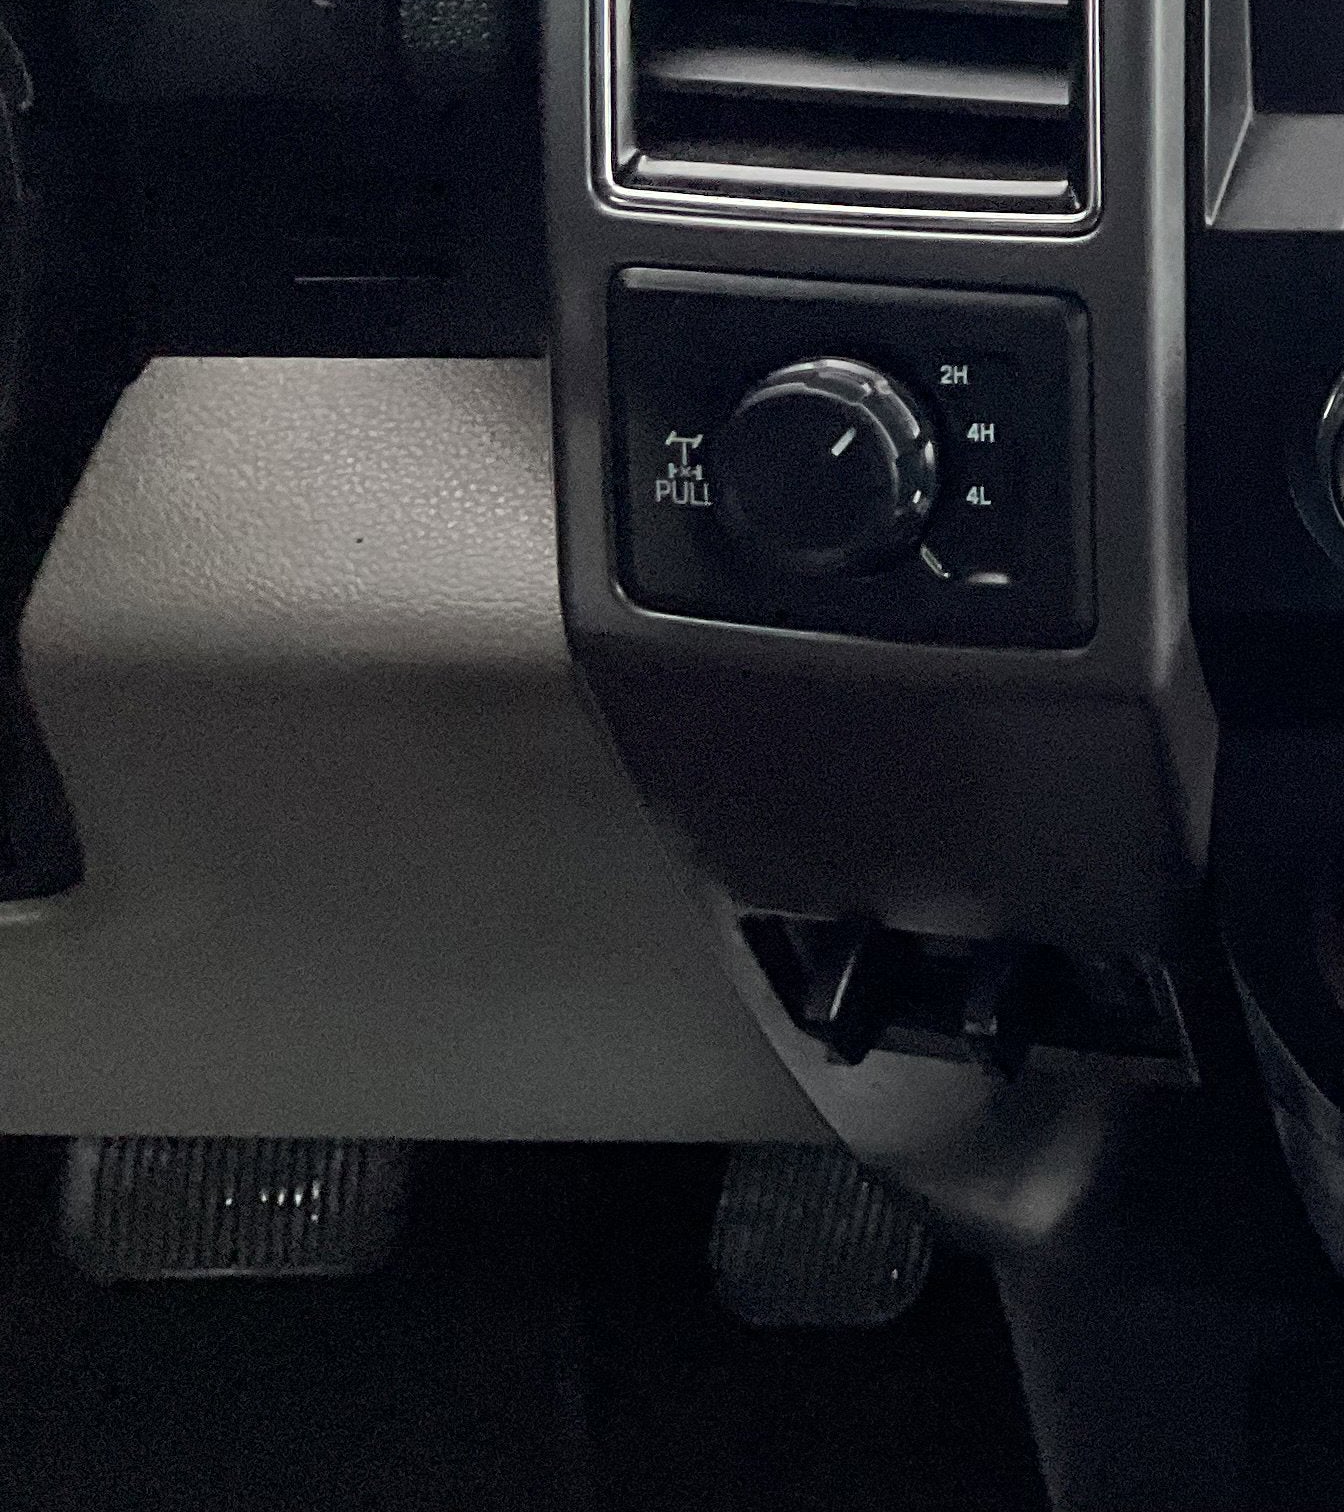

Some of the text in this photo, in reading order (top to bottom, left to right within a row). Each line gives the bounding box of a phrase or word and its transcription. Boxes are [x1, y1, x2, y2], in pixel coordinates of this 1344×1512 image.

[941, 365, 968, 384] 2H
[967, 423, 994, 442] 4H
[966, 486, 991, 505] 4L
